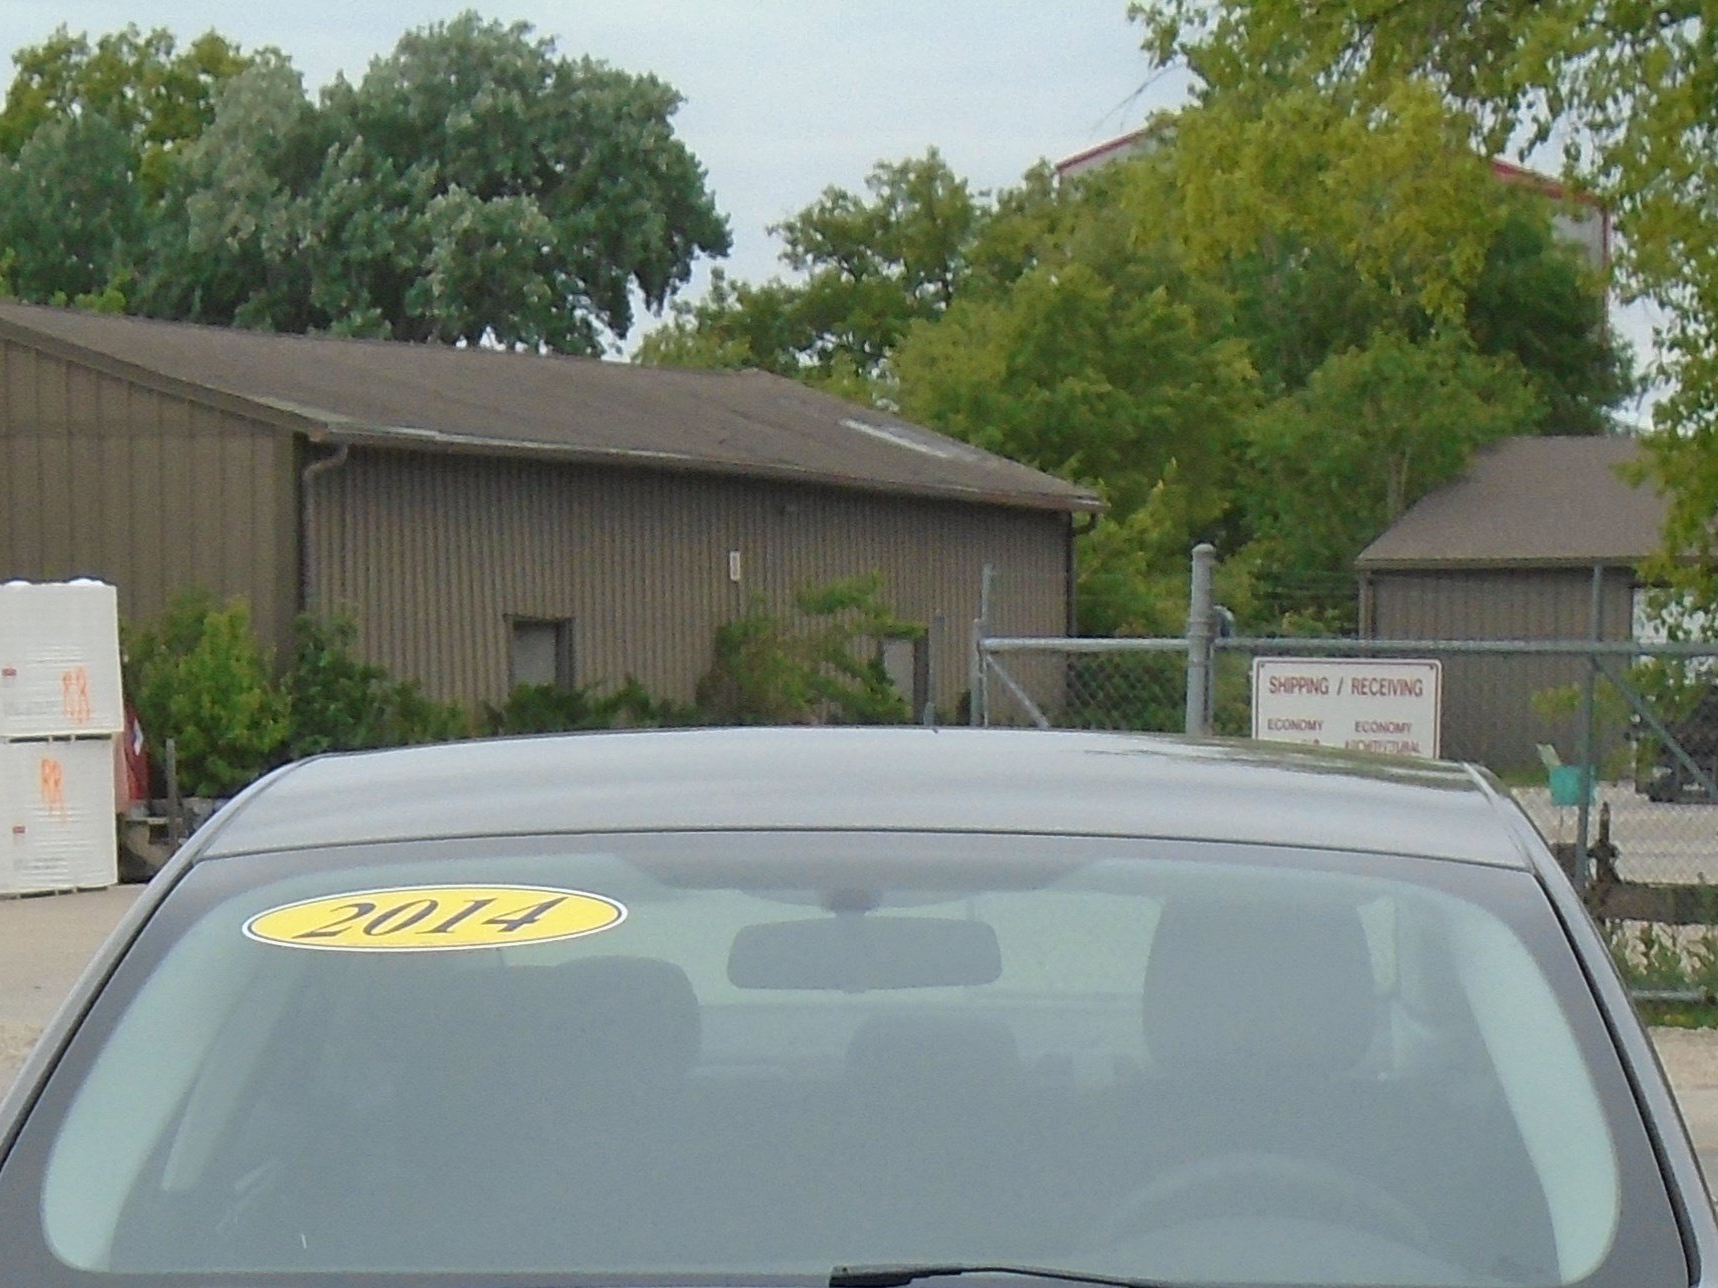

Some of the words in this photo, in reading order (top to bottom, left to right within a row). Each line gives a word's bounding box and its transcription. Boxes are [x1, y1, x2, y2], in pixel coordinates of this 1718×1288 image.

[1268, 676, 1329, 696] SHIPPING
[1351, 678, 1423, 697] RECEIVING
[1267, 718, 1324, 732] ECONOMY
[1354, 720, 1413, 734] ECONOMY
[291, 896, 571, 940] 2014
